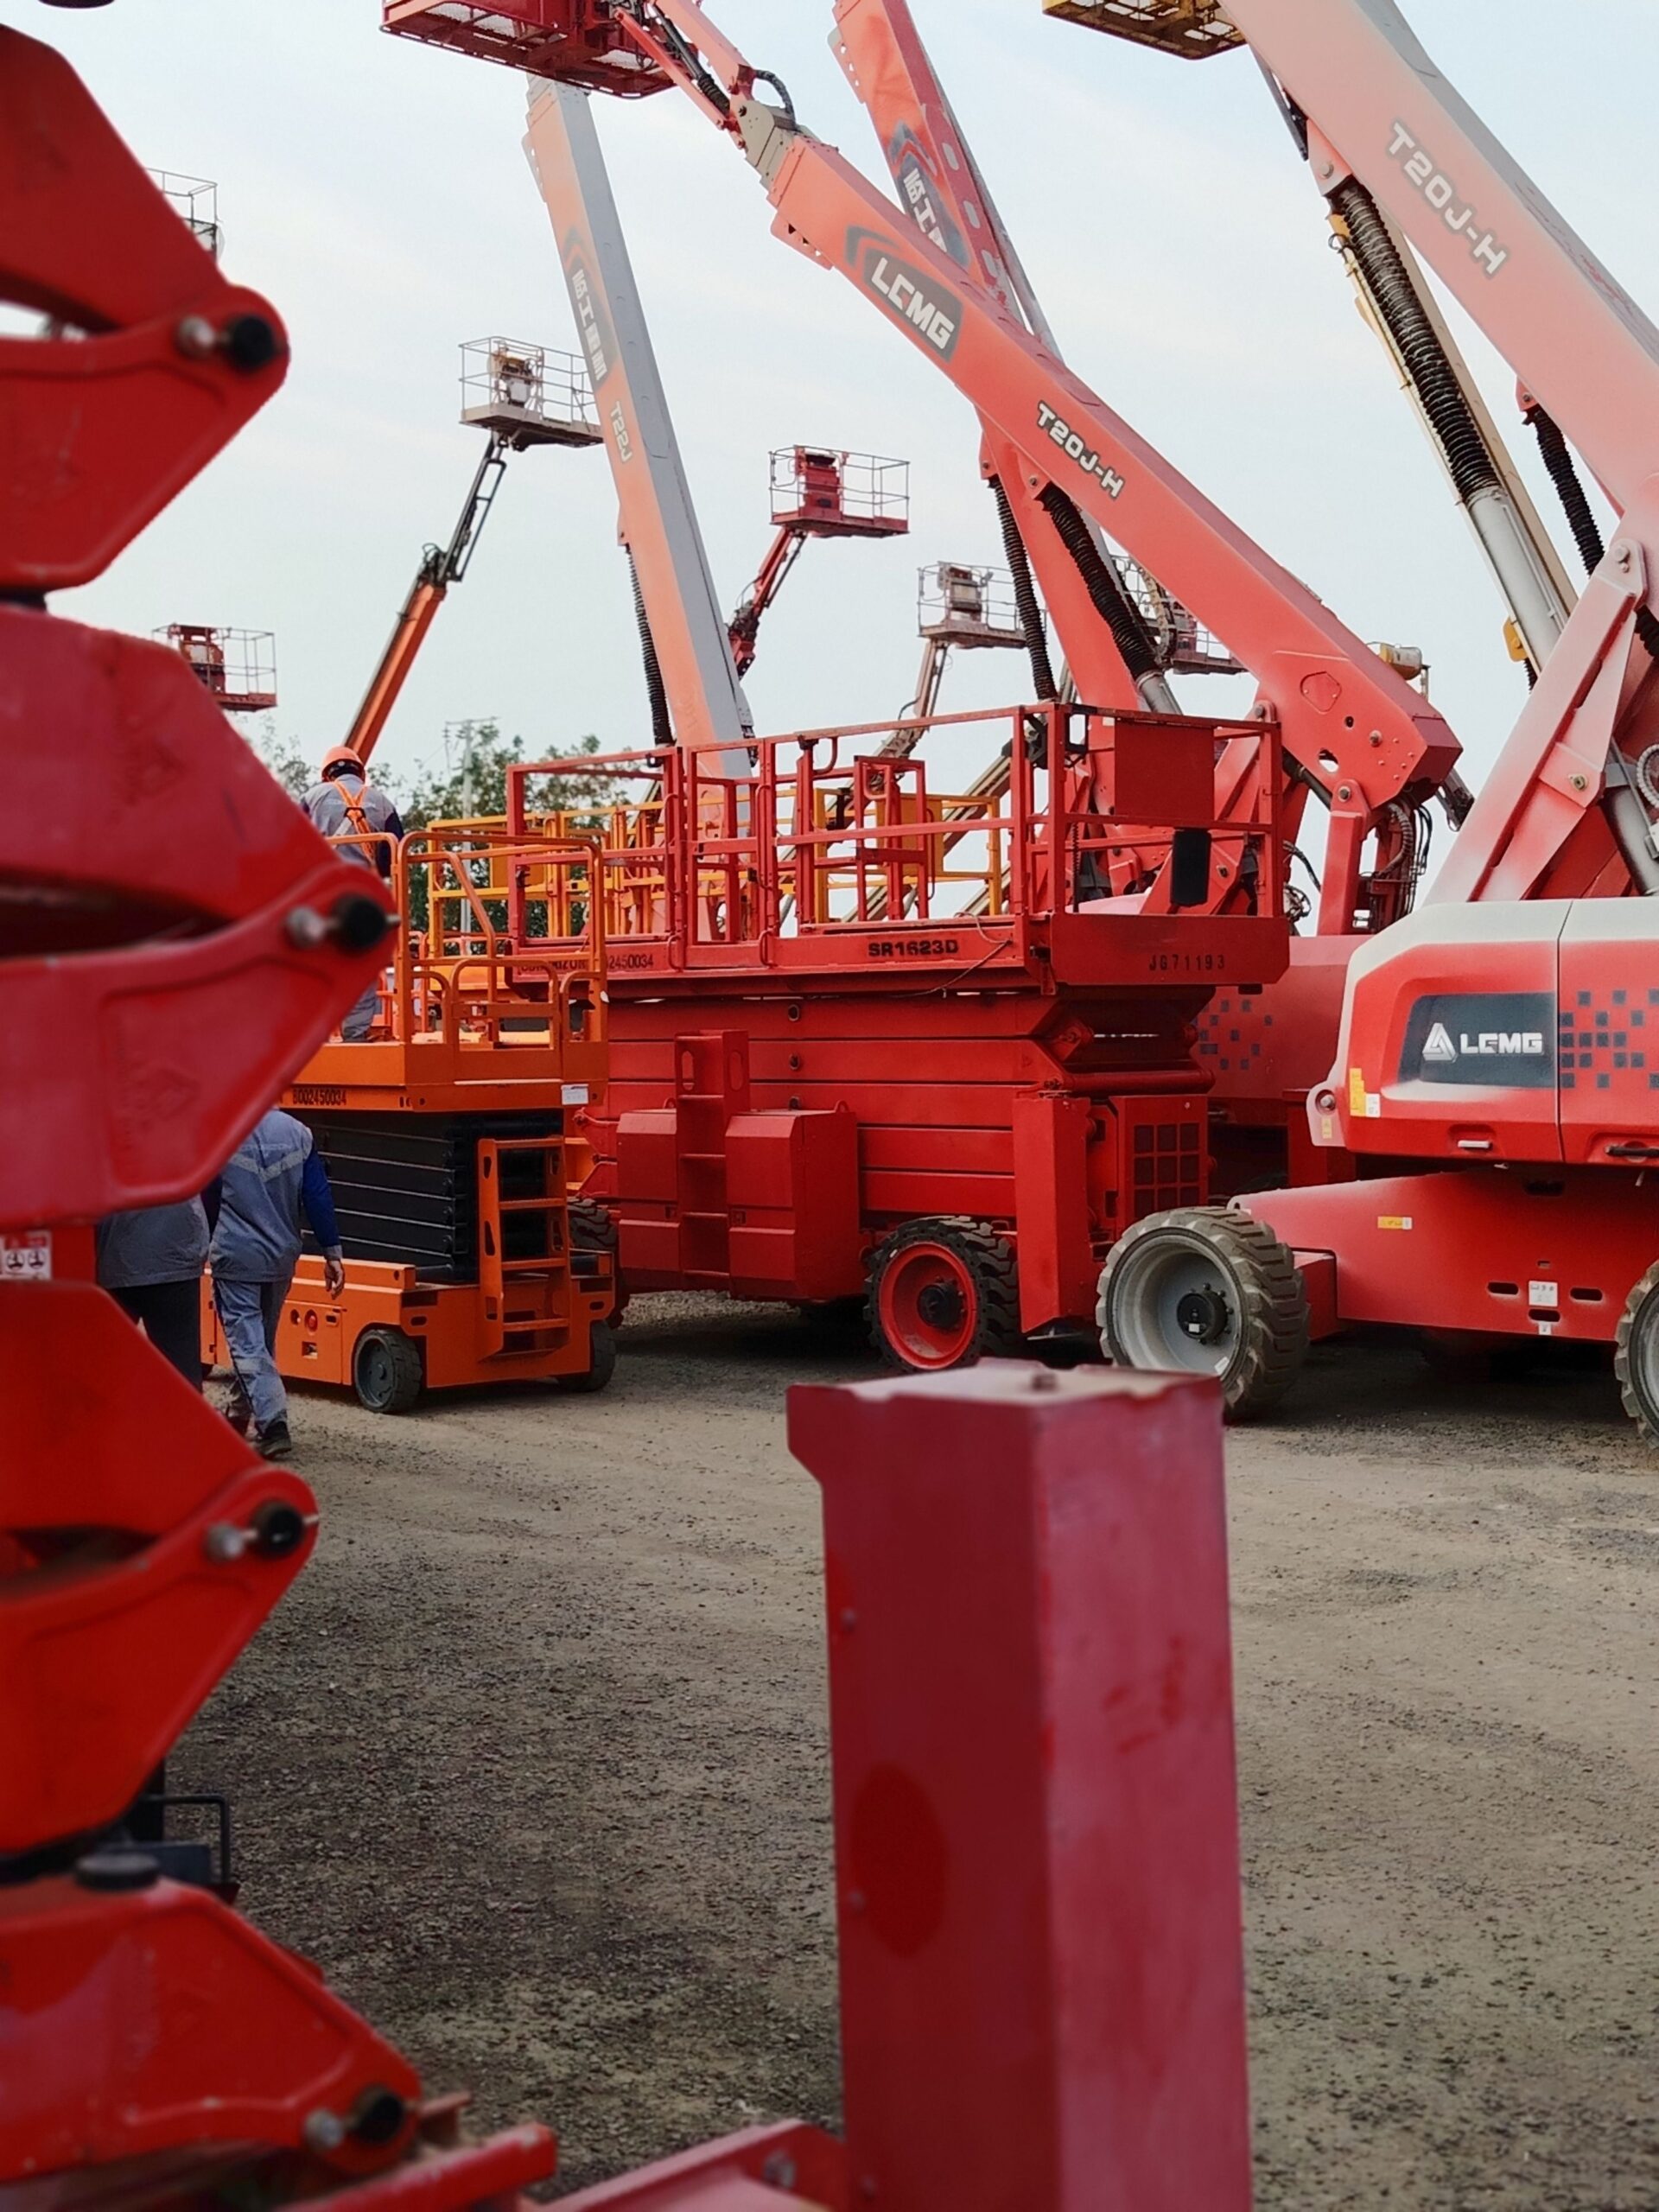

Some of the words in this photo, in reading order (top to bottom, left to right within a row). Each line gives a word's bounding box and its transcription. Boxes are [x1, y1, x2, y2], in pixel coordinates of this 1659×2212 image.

[1388, 121, 1508, 275] T20J-H
[1037, 401, 1125, 498] T20J-H
[868, 939, 959, 957] SR1623D
[1148, 954, 1225, 971] JG71193
